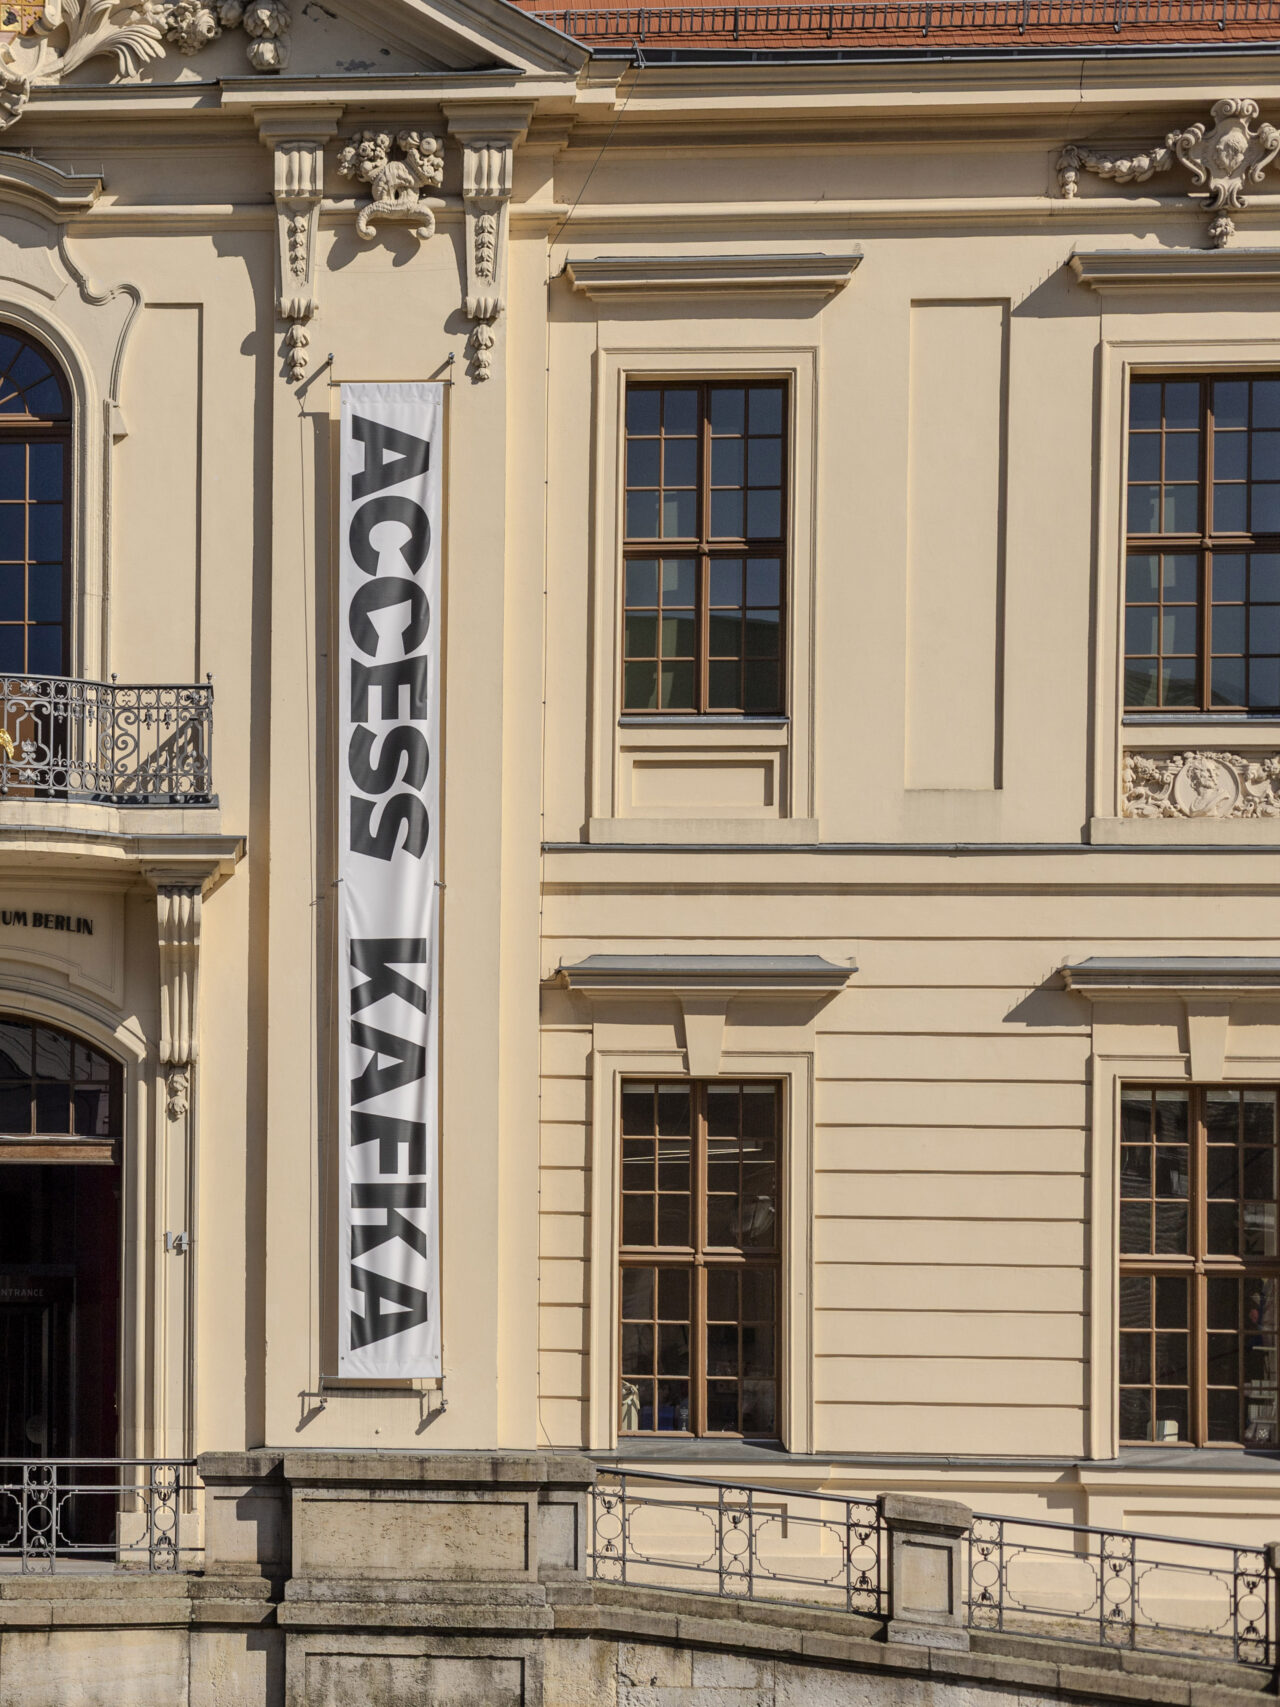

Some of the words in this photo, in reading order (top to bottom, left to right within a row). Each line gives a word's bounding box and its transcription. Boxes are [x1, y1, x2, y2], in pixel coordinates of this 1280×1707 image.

[349, 414, 430, 862] ACCESS
[32, 912, 94, 935] BERLIN
[166, 1231, 190, 1250] 14
[350, 938, 428, 1352] KAFKA
